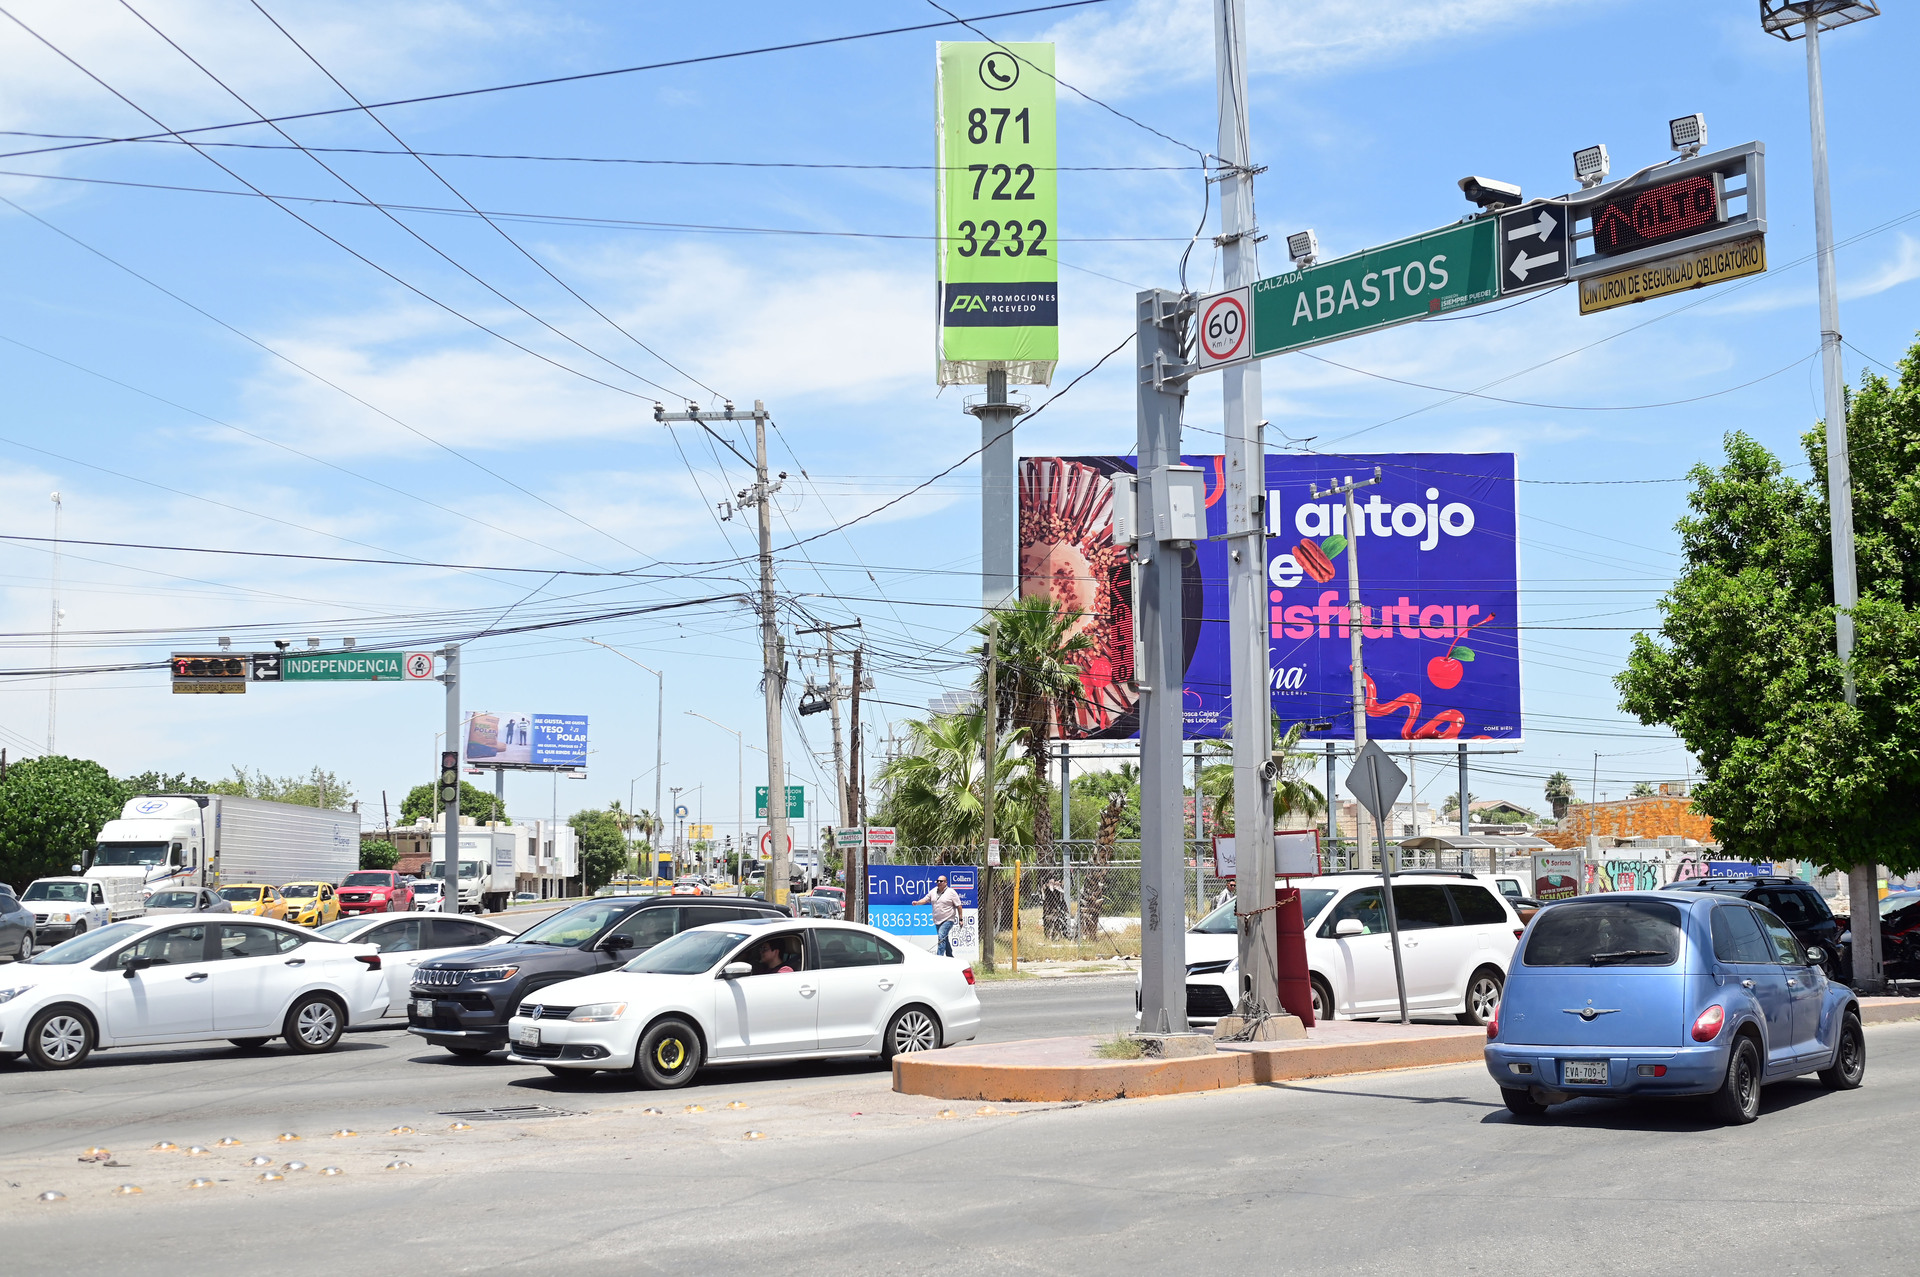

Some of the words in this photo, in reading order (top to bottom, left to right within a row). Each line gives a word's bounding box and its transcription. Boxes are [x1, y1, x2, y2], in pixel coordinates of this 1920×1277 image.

[968, 107, 1030, 144] 871
[968, 163, 1036, 200] 722
[958, 219, 1048, 257] 3232
[1257, 270, 1303, 292] CALZADA
[1292, 254, 1448, 326] ABASTOS
[1584, 280, 1626, 305] CINTURON
[1628, 274, 1640, 294] DE
[1642, 262, 1693, 292] SEGURIDAD
[1696, 245, 1758, 278] OBLIGATORIO
[1209, 310, 1238, 338] 60
[1265, 490, 1281, 536] l
[1294, 488, 1475, 551] antojo
[1268, 554, 1304, 588] e
[1270, 590, 1480, 639] isfrutar
[287, 660, 398, 673] INDEPENDENCIA
[868, 875, 888, 894] En
[895, 875, 937, 895] Rent
[914, 913, 935, 927] 533
[1565, 1067, 1606, 1078] EVA-709-C
